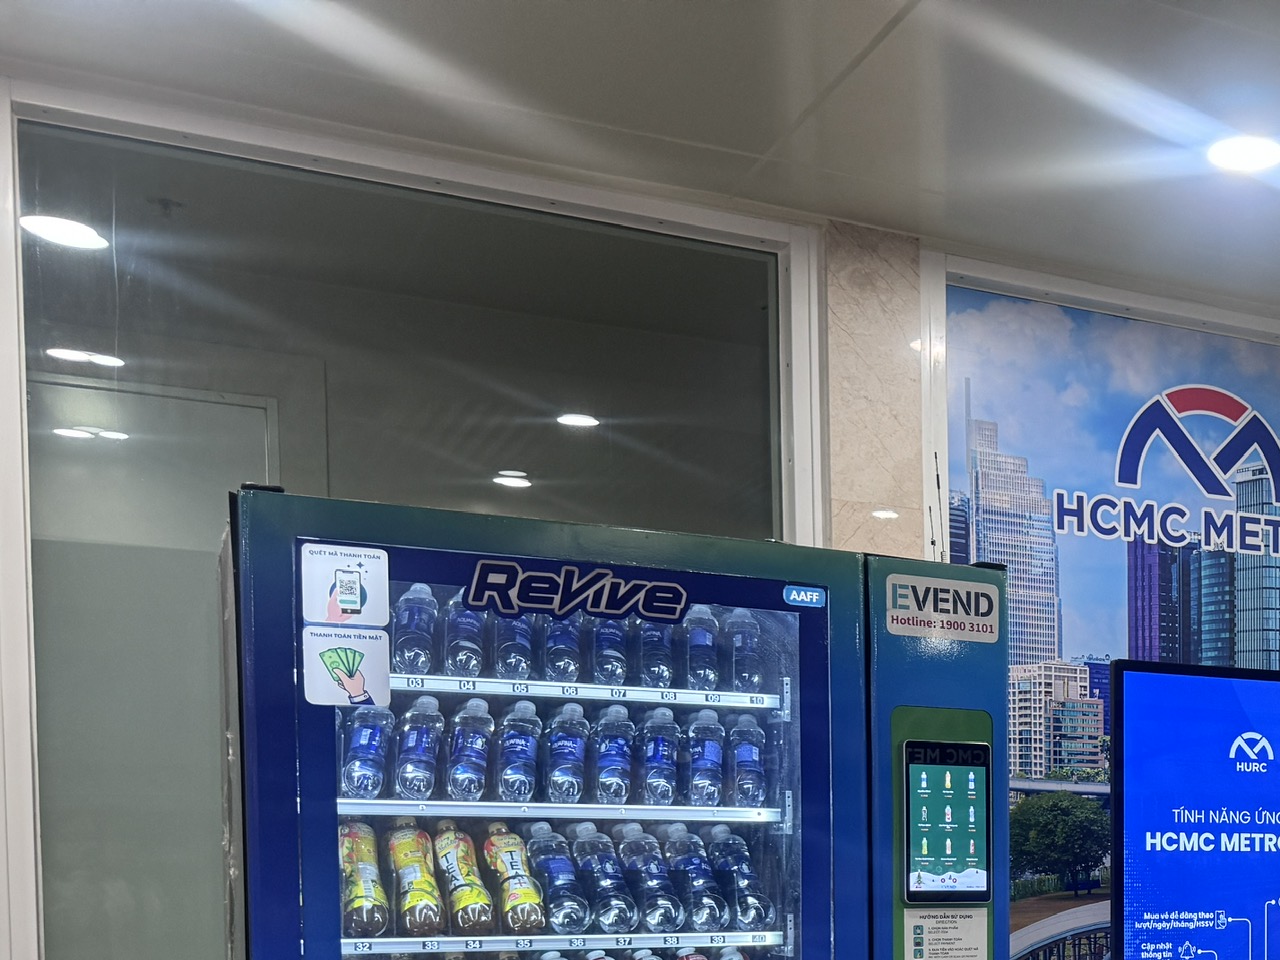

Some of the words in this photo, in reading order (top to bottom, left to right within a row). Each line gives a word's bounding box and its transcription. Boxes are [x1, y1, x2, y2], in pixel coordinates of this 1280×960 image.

[1054, 490, 1189, 546] HCMC
[790, 590, 820, 602] AAFF
[891, 583, 994, 618] EVEND
[891, 614, 937, 629] Hotline:
[939, 620, 966, 632] 1900
[968, 622, 994, 634] 3101
[409, 679, 423, 687] 03
[1236, 762, 1268, 773] HURC
[1172, 806, 1205, 823] TÍNH
[1209, 807, 1251, 824] NĂNG
[1145, 832, 1215, 851] HCMC
[467, 941, 480, 949] 34
[571, 939, 584, 947] 36
[665, 937, 678, 945] 38
[356, 943, 370, 951] 32
